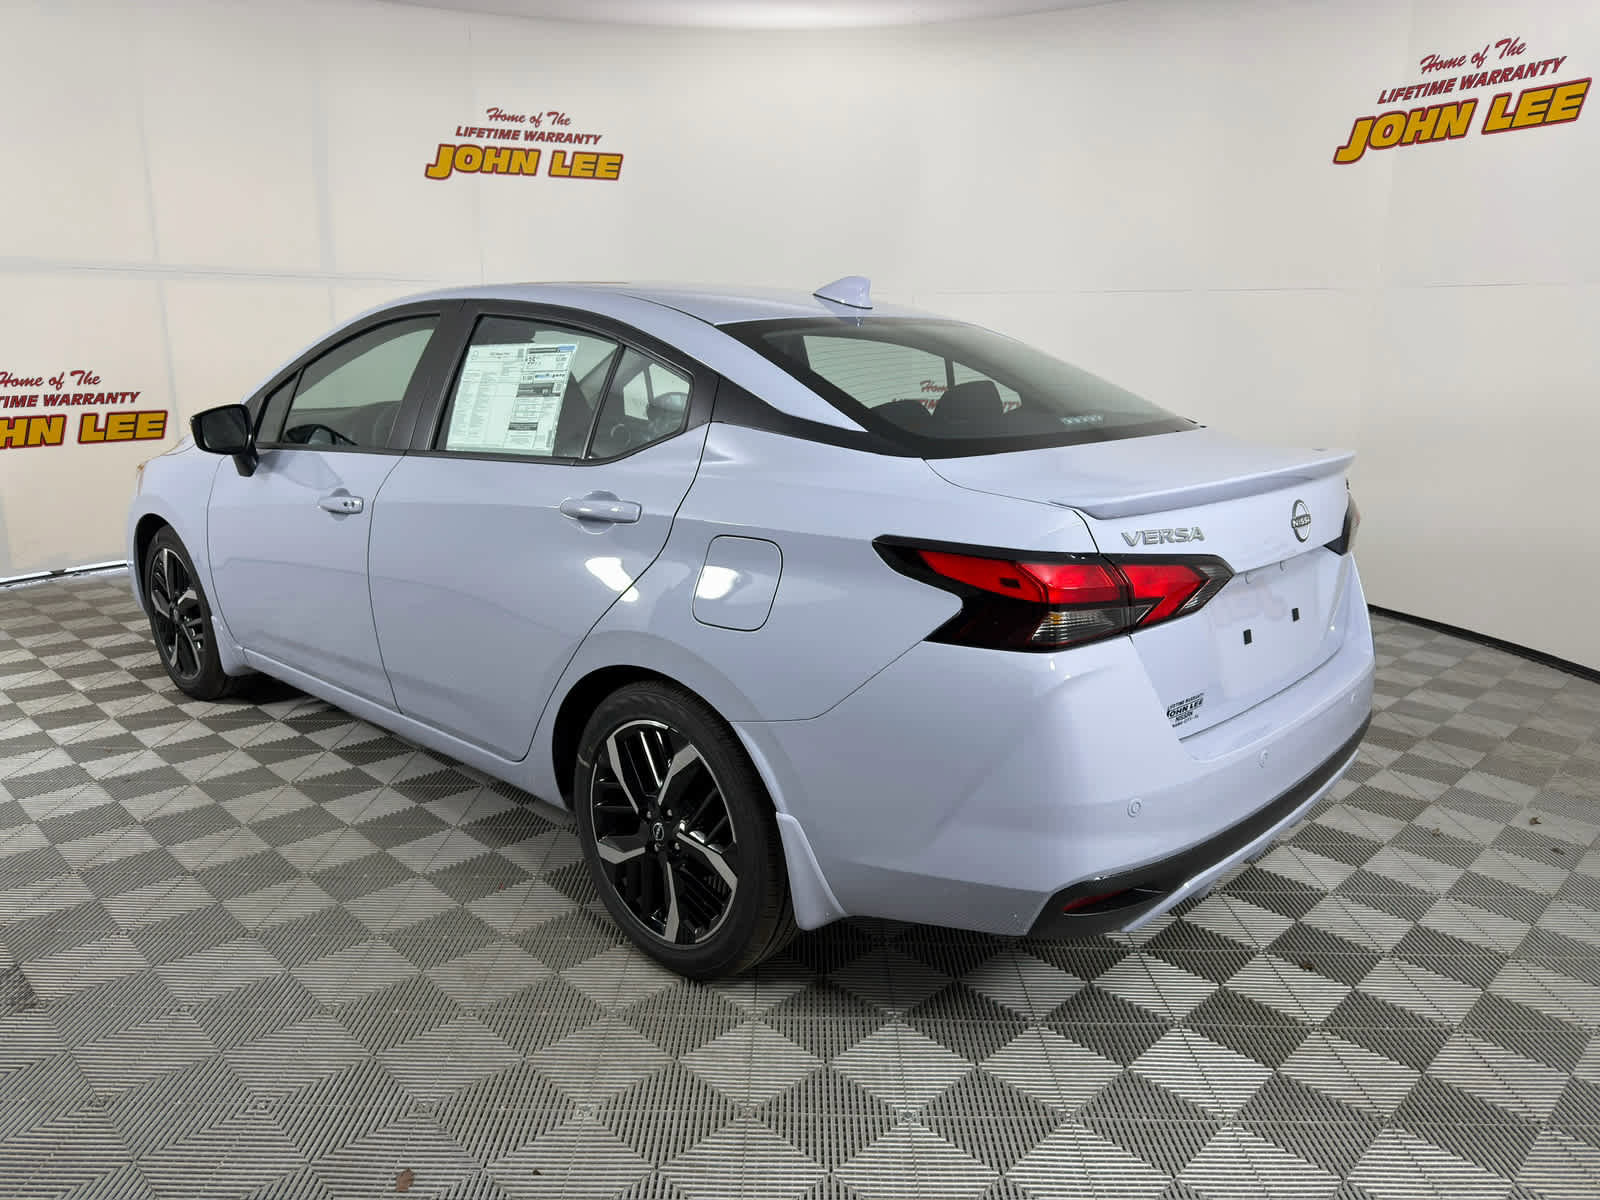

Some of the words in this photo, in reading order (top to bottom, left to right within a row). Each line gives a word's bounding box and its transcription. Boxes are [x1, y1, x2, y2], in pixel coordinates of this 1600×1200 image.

[1420, 54, 1466, 74] Home
[1471, 45, 1490, 68] of
[1495, 37, 1527, 59] The
[1377, 78, 1457, 104] LIFETIME
[1459, 56, 1567, 92] WARRANTY
[486, 107, 526, 124] Home
[529, 112, 543, 127] of
[547, 111, 571, 126] The
[1333, 98, 1478, 164] JOHN
[1481, 77, 1592, 135] LEE
[455, 126, 521, 141] LIFETIME
[524, 130, 602, 145] WARRANTY
[425, 144, 541, 180] JOHN
[548, 150, 624, 180] LEE
[0, 371, 44, 388] Home
[49, 371, 65, 391] of
[70, 370, 101, 386] The
[43, 391, 141, 407] WARRANTY
[78, 409, 168, 444] LEE
[1121, 526, 1205, 547] VERSA
